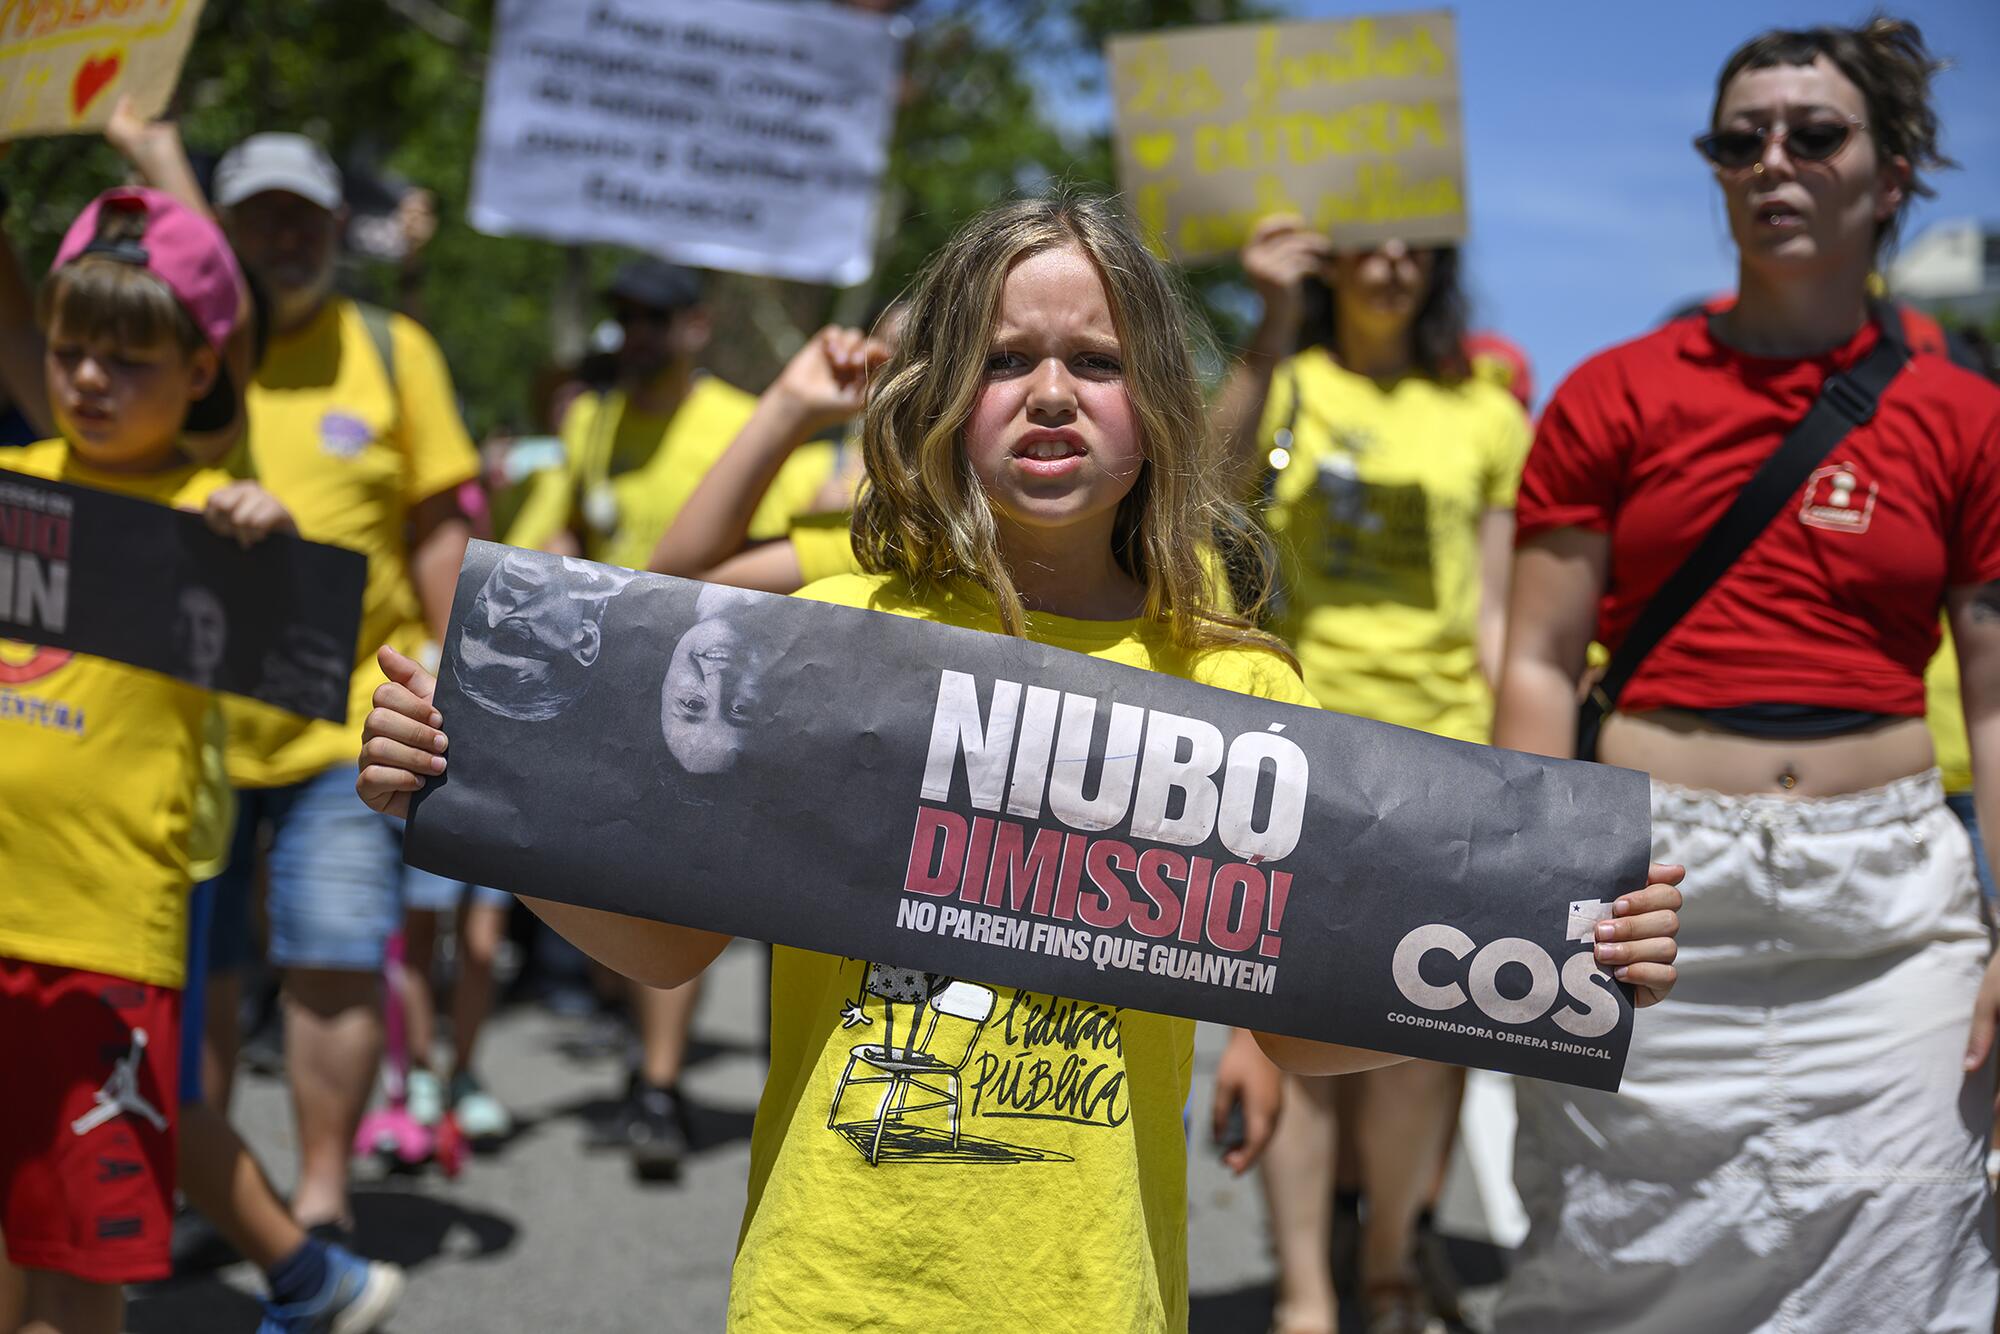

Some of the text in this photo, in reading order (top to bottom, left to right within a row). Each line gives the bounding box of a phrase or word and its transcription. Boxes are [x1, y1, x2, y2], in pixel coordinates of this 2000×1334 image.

[920, 669, 1309, 863] NIUBÓ
[903, 805, 1294, 958] DIMISSIÓ!
[896, 898, 1278, 995] NO PAREM FINS QUE GUANYEM
[1392, 923, 1620, 1038] COS
[1387, 1011, 1612, 1061] COORDINADORA OBRERA SINDICAL
